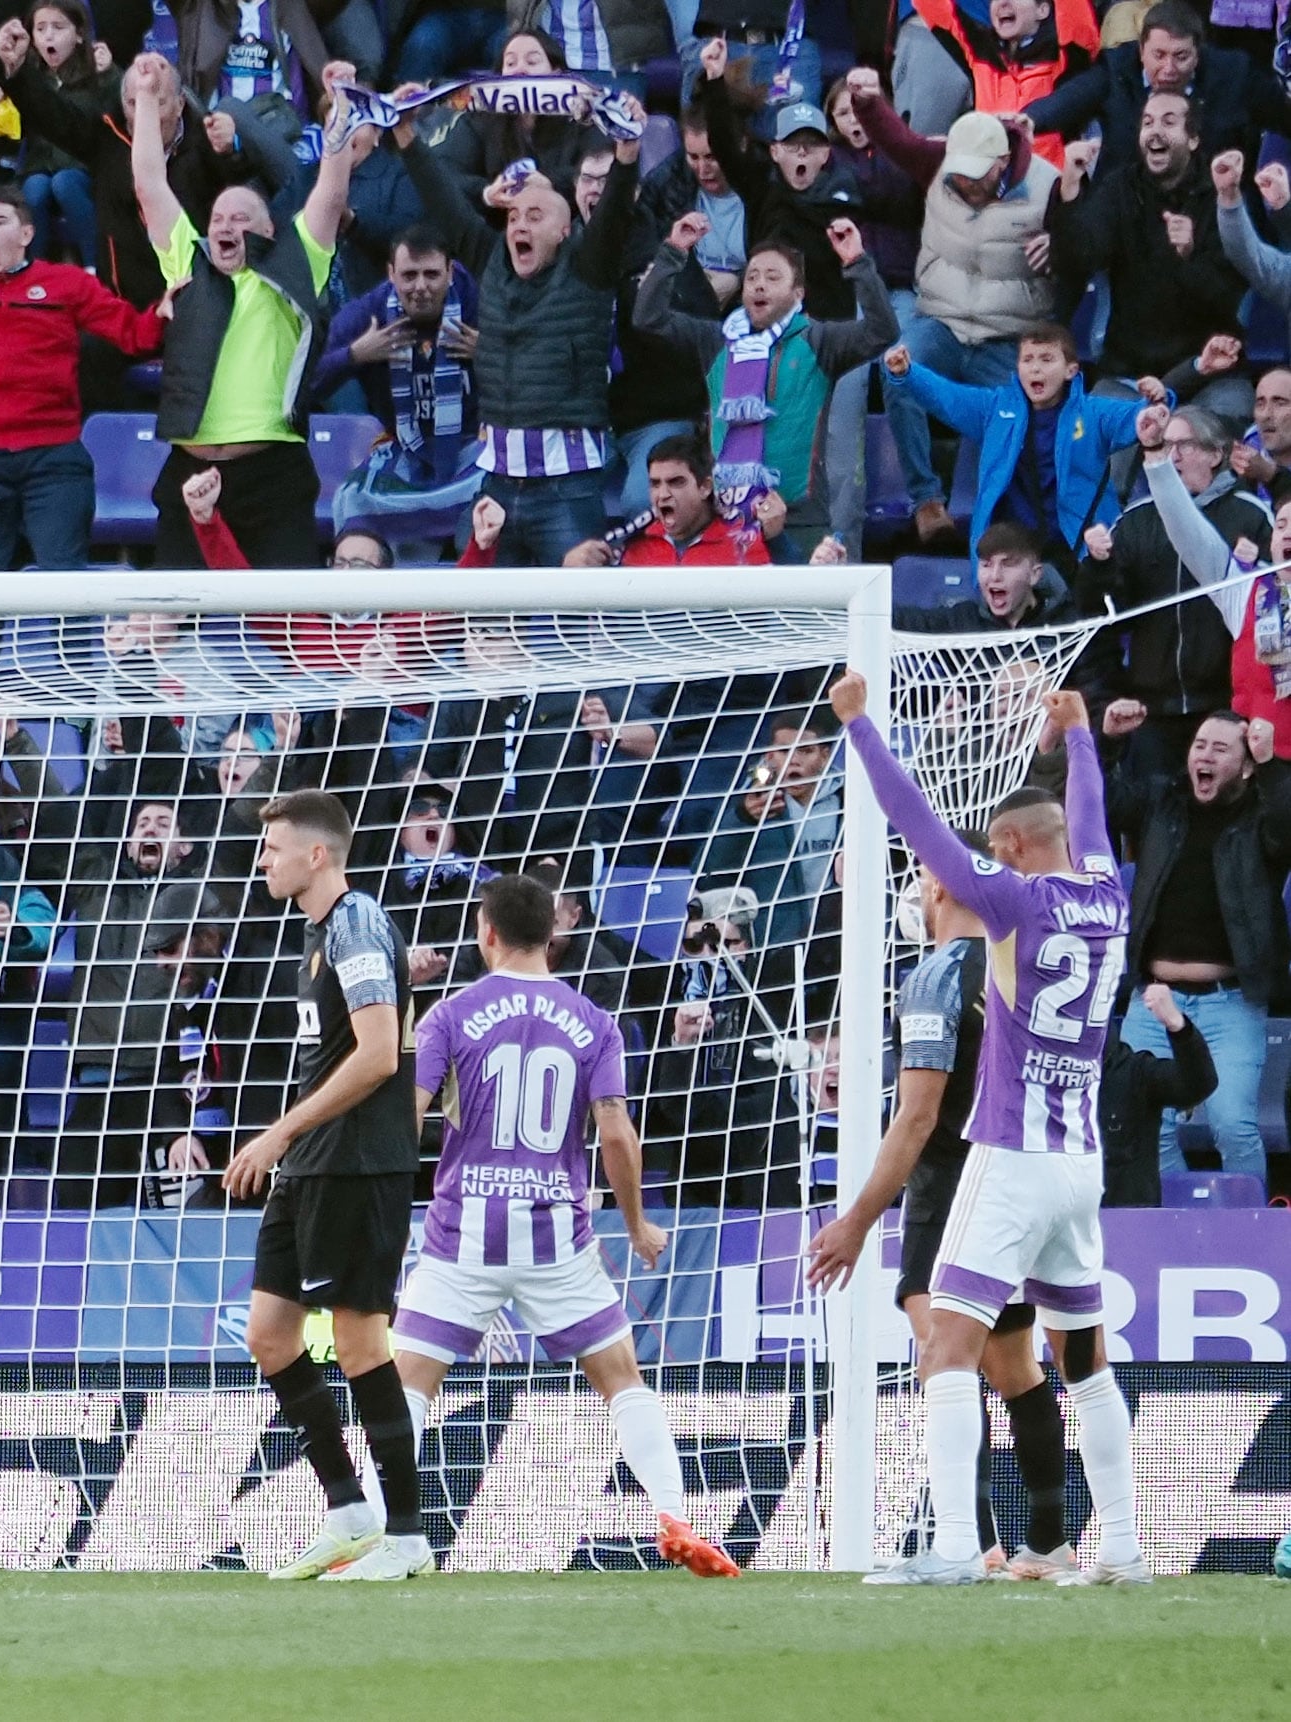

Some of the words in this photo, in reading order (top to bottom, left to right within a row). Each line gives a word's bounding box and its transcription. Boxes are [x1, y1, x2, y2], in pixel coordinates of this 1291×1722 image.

[533, 994, 595, 1049] PLANO
[482, 1043, 578, 1154] 10
[460, 1180, 576, 1201] NUTRITION
